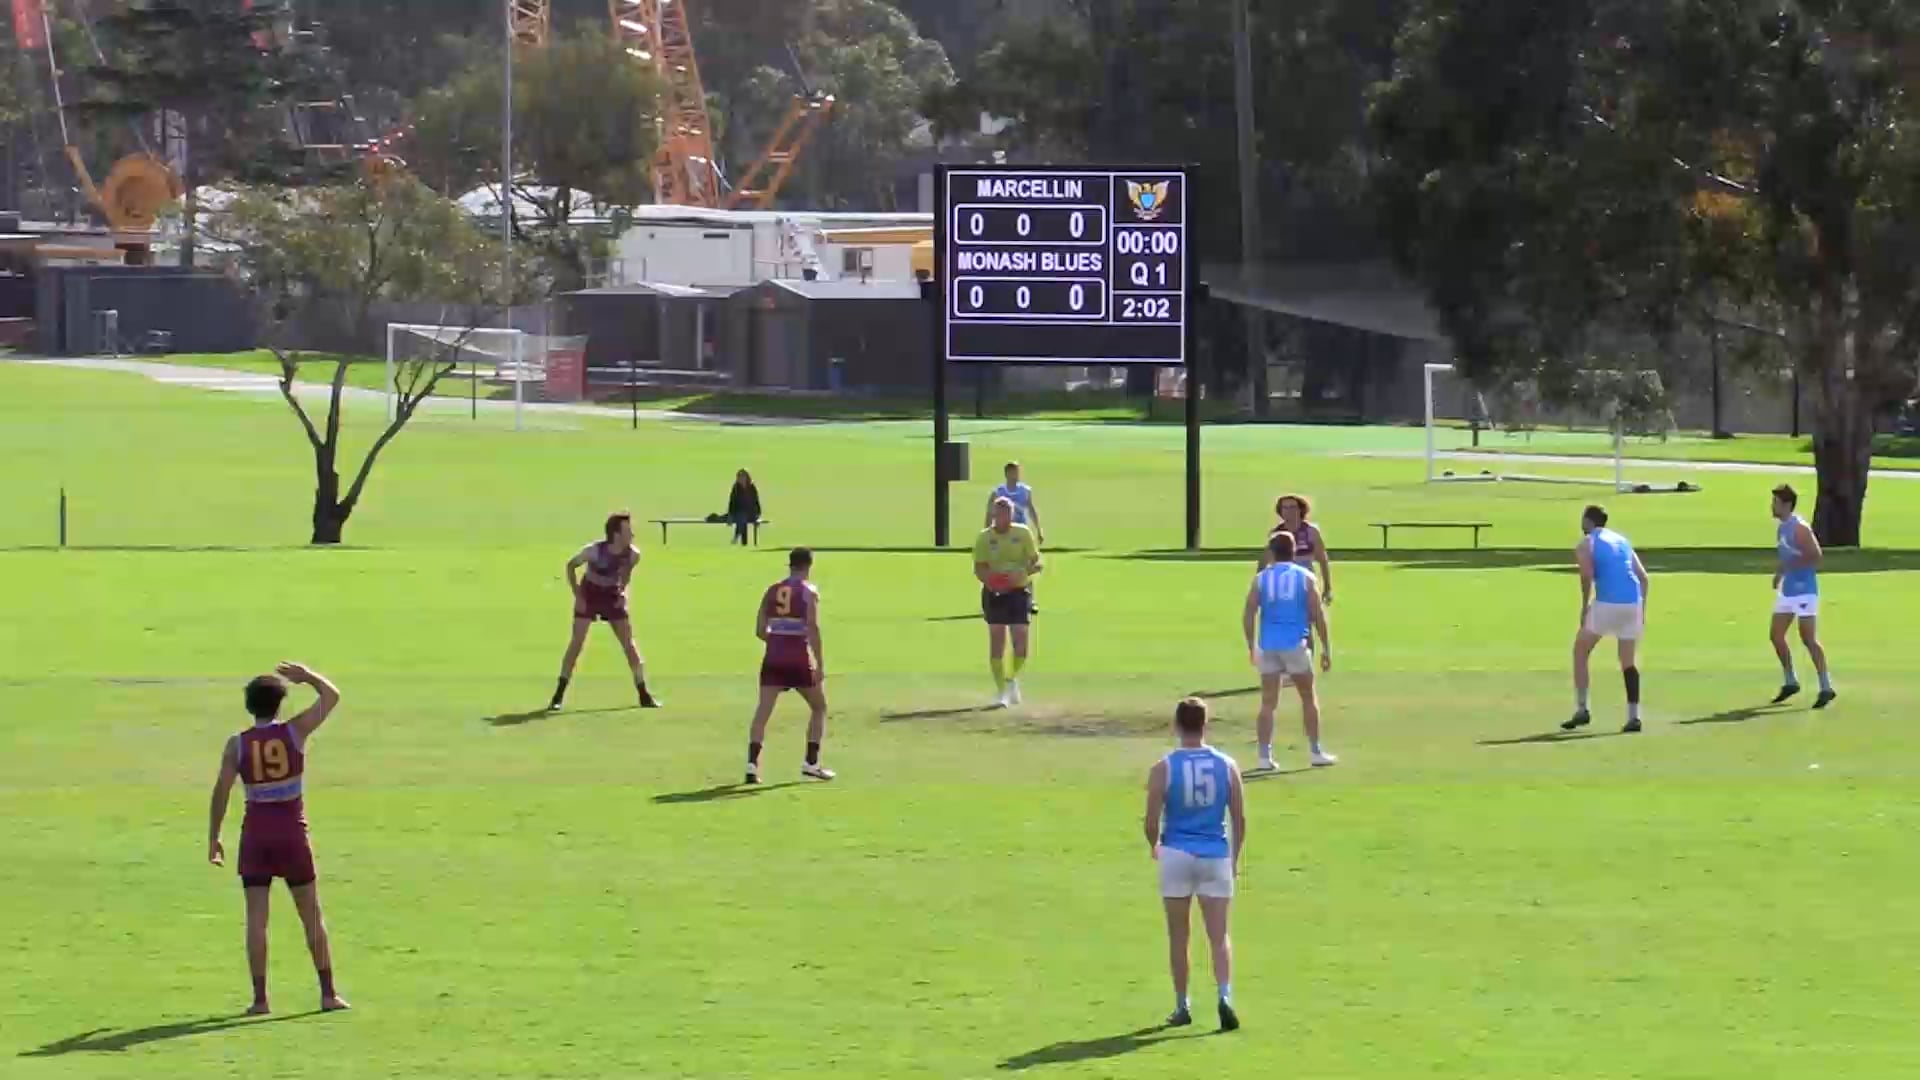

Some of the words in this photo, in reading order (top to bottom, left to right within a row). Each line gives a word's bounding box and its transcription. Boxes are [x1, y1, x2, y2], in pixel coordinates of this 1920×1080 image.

[977, 179, 1083, 198] MARCELLIN
[970, 213, 984, 236] 0
[1017, 213, 1031, 236] 0
[1070, 212, 1084, 238] 0
[1117, 231, 1178, 255] 00:00
[958, 252, 1036, 271] MONASH
[1042, 252, 1103, 271] BLUES
[1130, 262, 1149, 286] Q
[1156, 262, 1167, 285] 1
[970, 286, 984, 309] 0
[1017, 286, 1031, 309] 0
[1070, 284, 1084, 311] 0
[1122, 298, 1170, 318] 2:02
[1267, 570, 1298, 602] 10
[776, 586, 792, 615] 9
[251, 738, 290, 782] 19
[1182, 758, 1217, 808] 15
